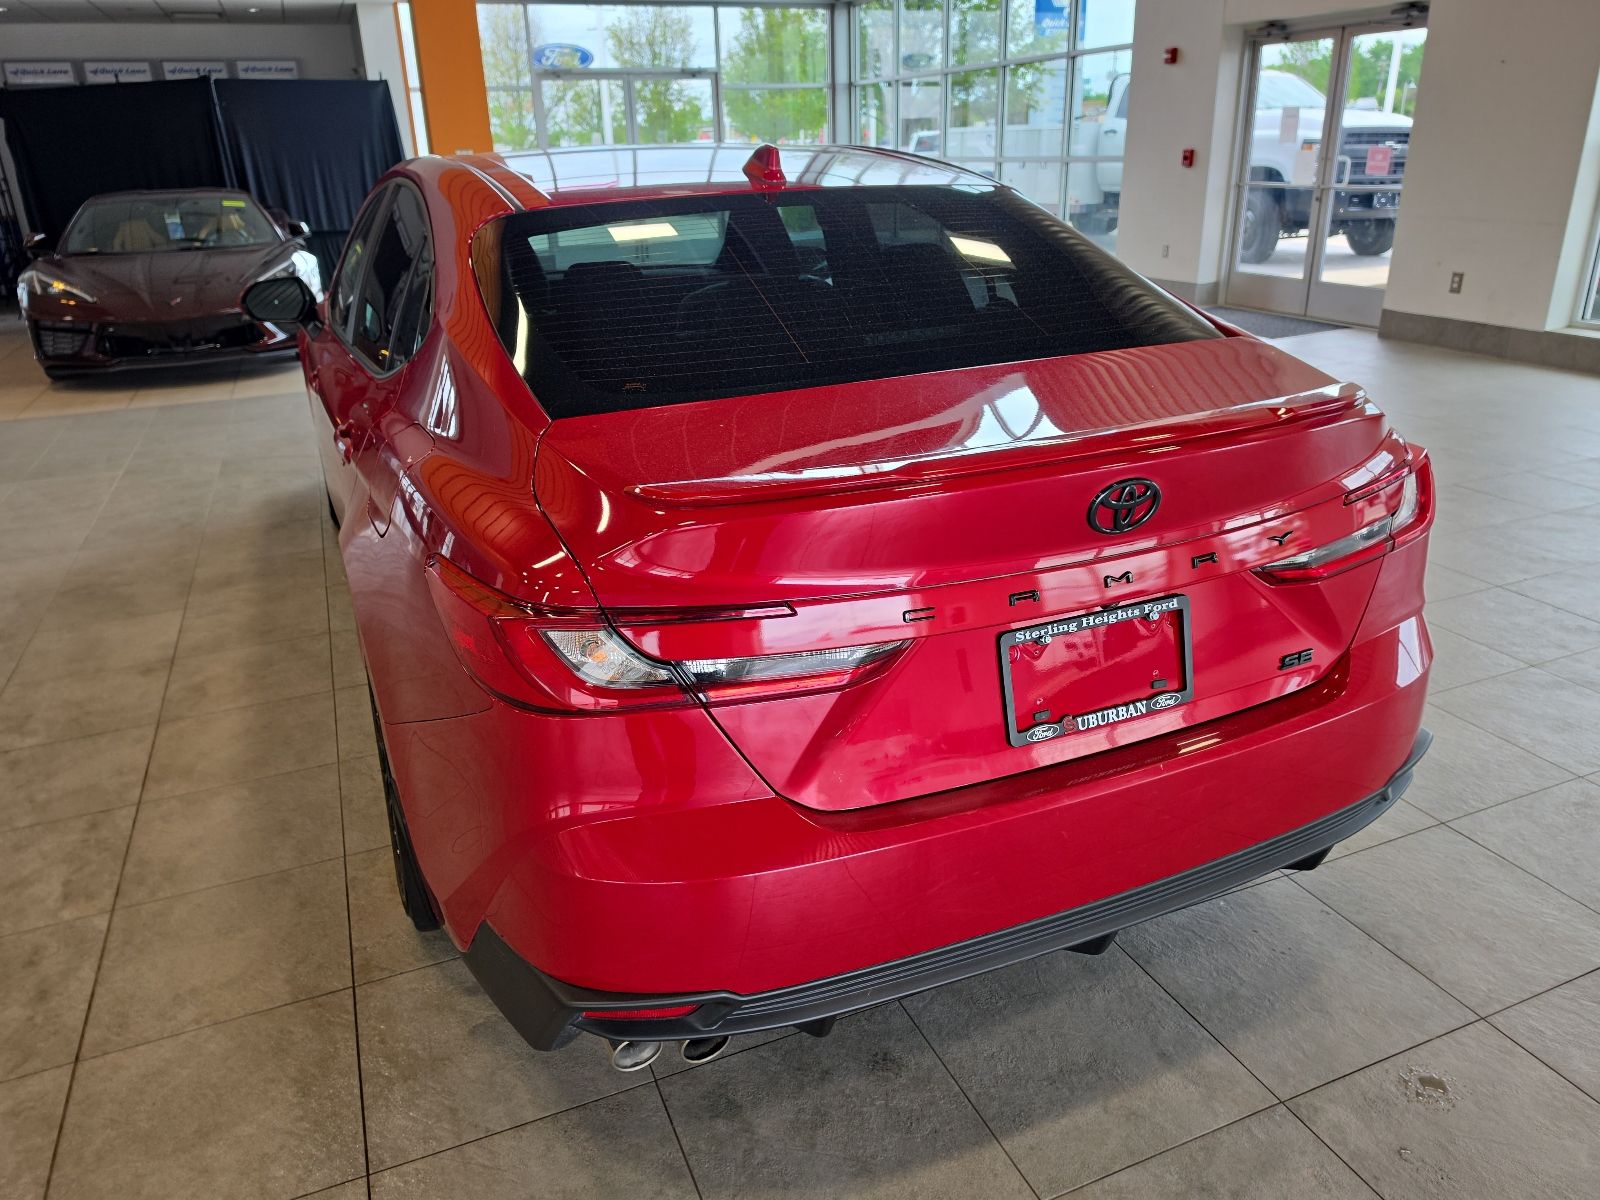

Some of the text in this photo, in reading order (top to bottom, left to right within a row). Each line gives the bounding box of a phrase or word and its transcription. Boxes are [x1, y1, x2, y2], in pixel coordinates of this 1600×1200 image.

[541, 47, 581, 66] Fod
[902, 530, 1294, 624] CAMRY
[1015, 598, 1179, 643] Sterling Heights Ford
[1278, 648, 1315, 670] SE
[1063, 700, 1147, 734] SUBURBAN
